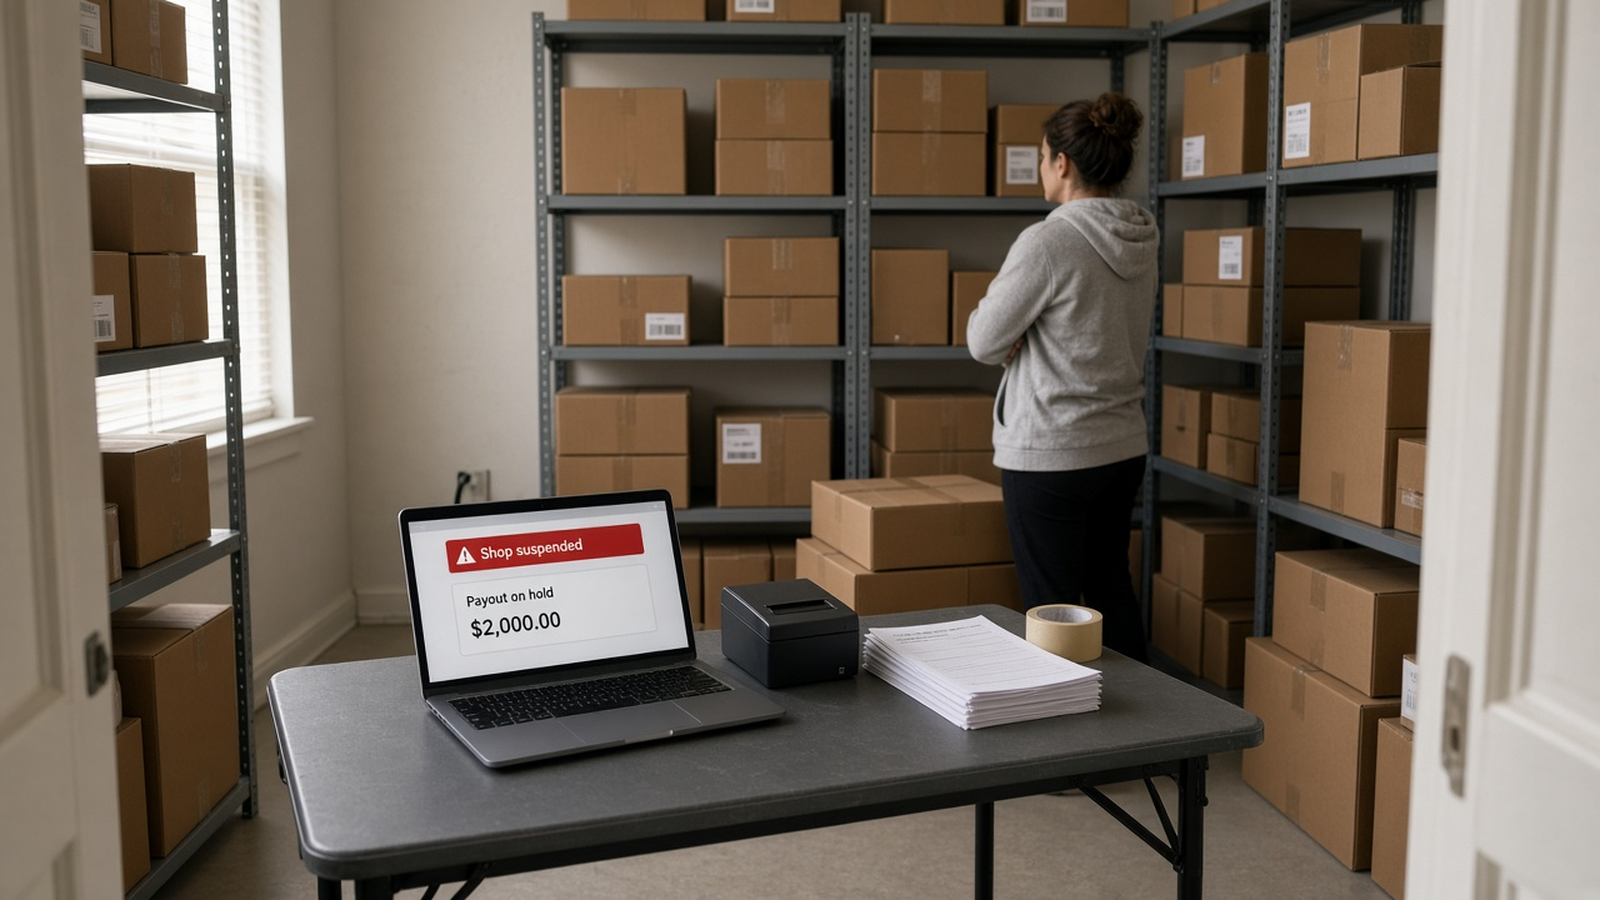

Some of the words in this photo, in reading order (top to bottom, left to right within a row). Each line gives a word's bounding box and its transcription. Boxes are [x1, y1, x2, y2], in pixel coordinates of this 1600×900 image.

[480, 546, 513, 560] Shop
[516, 538, 583, 557] suspended
[466, 593, 508, 608] Payout
[511, 592, 526, 602] on
[528, 586, 554, 600] hold
[471, 611, 561, 639] $2,000.00
